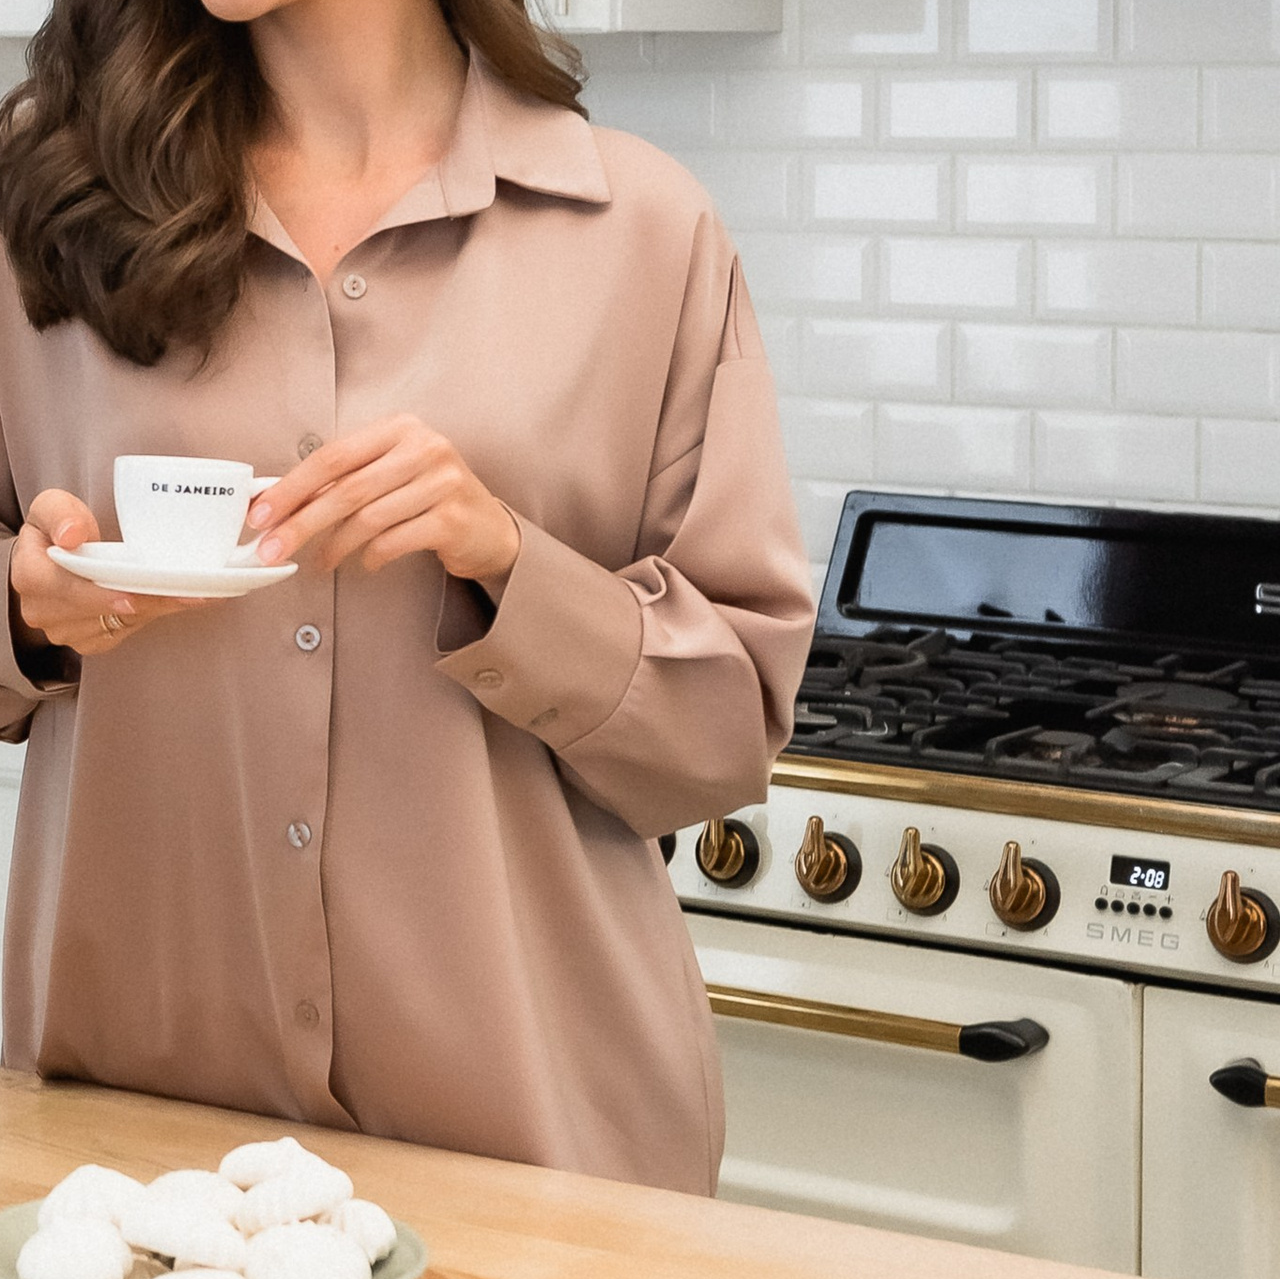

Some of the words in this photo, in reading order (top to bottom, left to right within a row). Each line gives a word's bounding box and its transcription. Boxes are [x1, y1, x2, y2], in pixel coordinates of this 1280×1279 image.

[151, 482, 169, 493] DE
[174, 485, 235, 496] JANEIRO
[1086, 922, 1180, 950] SMEG
